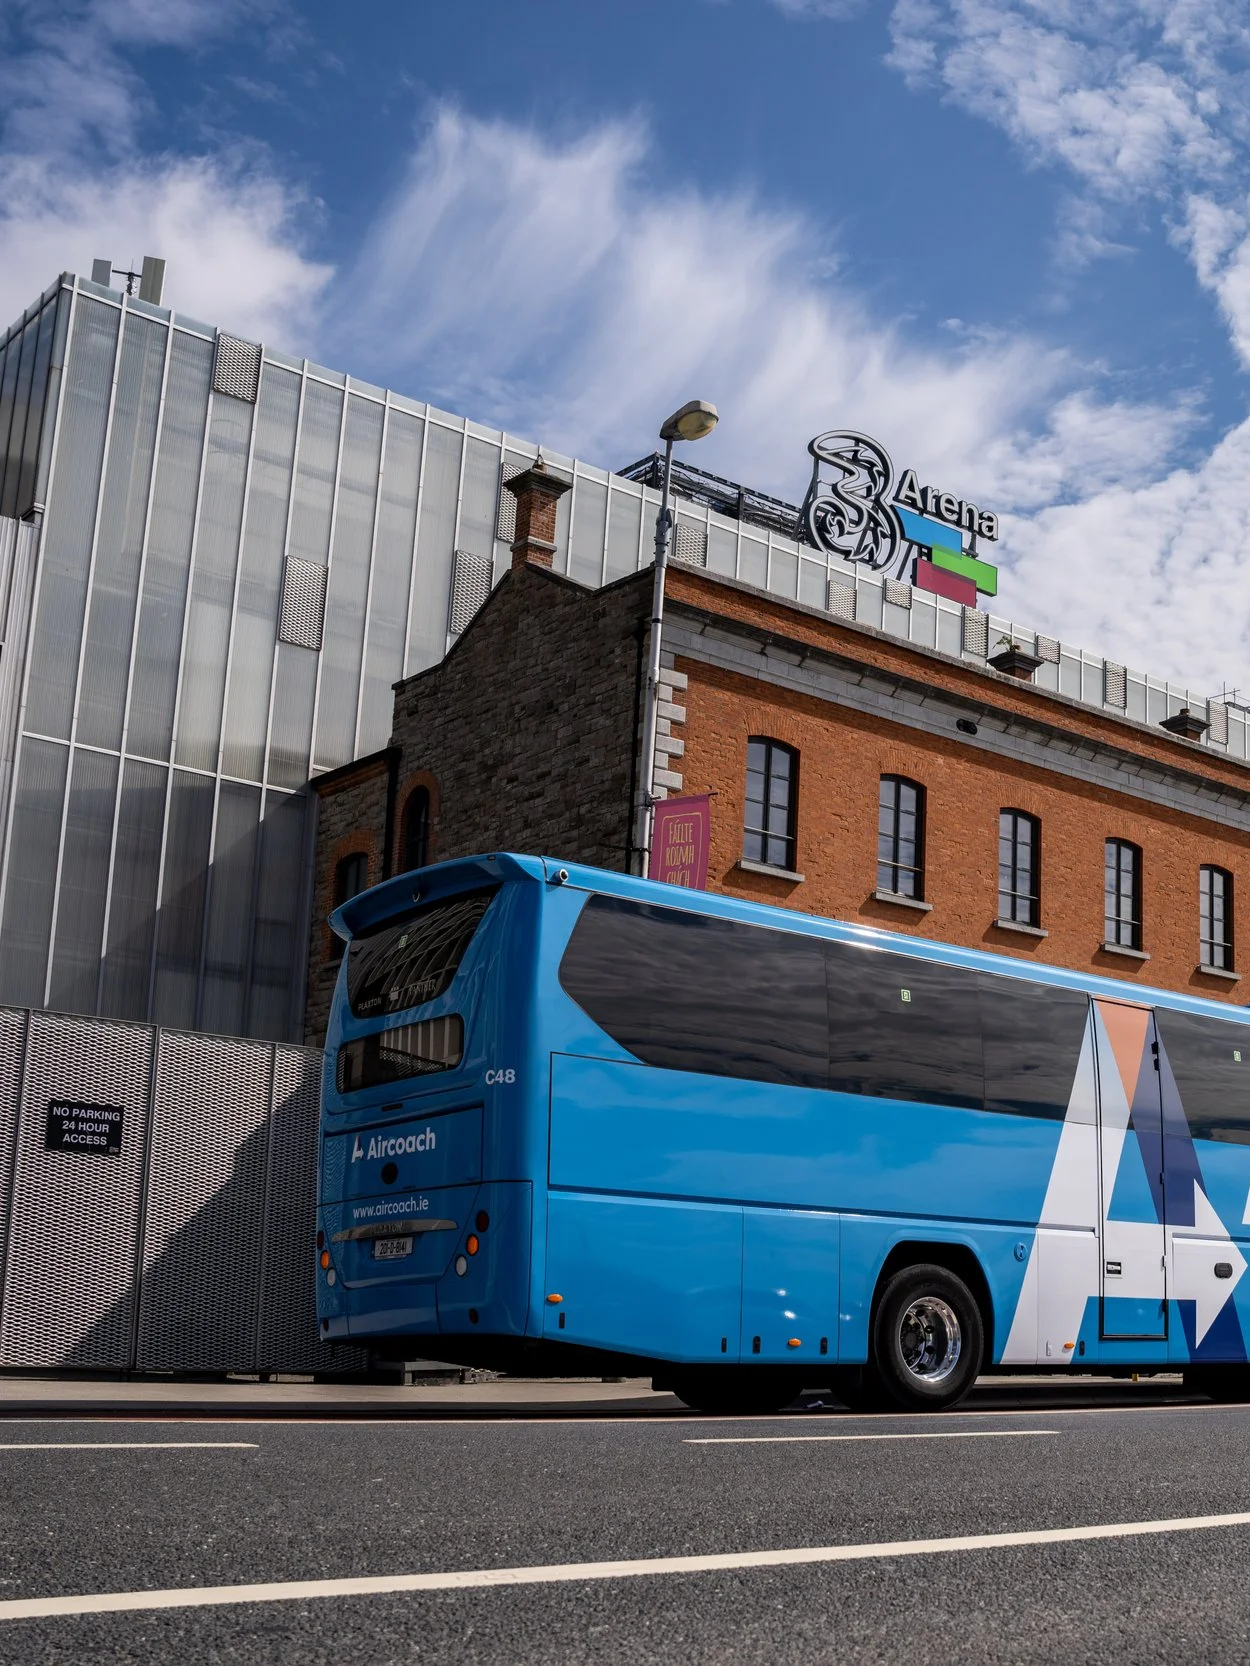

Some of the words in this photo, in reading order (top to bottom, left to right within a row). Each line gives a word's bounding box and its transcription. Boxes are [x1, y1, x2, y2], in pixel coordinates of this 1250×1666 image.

[896, 469, 998, 541] Arena
[669, 819, 693, 843] FÁILTE
[665, 845, 695, 867] ROIMH
[357, 997, 382, 1011] PLAXTON
[485, 1068, 516, 1085] C48
[53, 1106, 69, 1116] NO
[72, 1108, 120, 1121] PARKING
[62, 1120, 75, 1130] 24
[78, 1122, 109, 1133] HOUR
[62, 1133, 107, 1145] ACCESS
[367, 1127, 436, 1160] Aircoach
[352, 1195, 429, 1219] www.aircoach.ie
